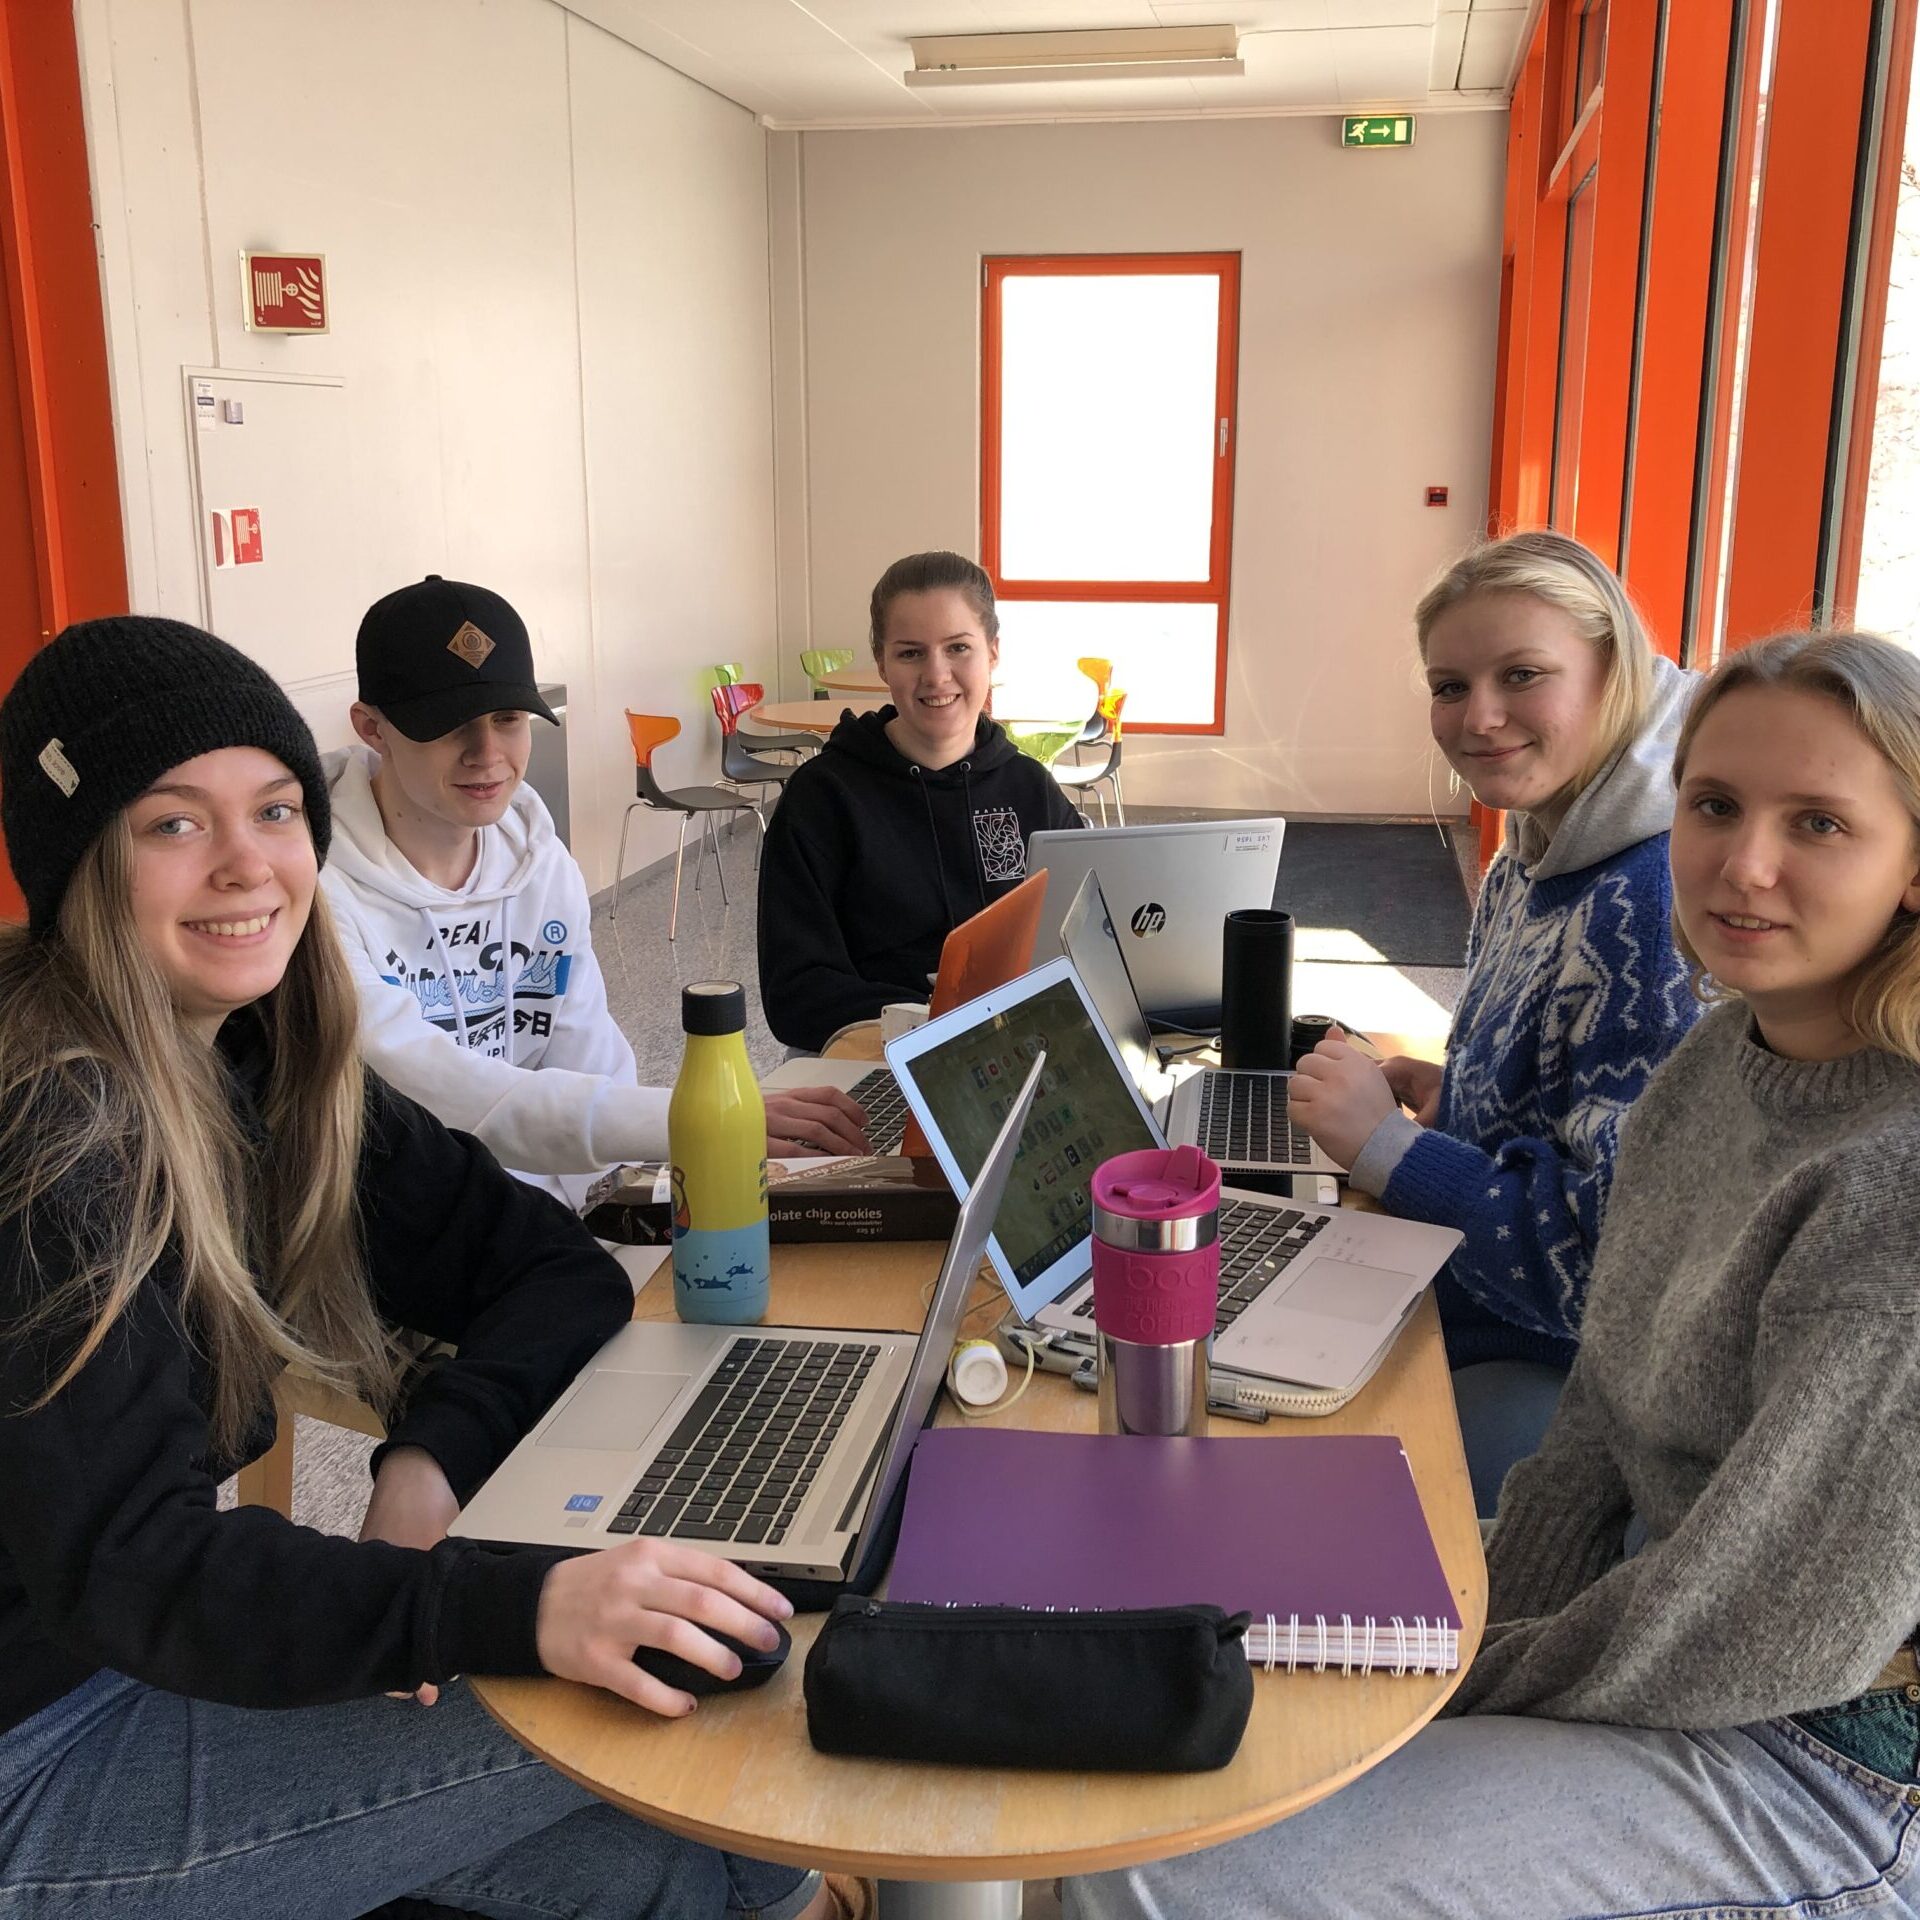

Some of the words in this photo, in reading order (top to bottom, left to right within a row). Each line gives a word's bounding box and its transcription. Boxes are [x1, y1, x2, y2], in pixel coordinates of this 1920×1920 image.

[1132, 902, 1166, 938] hp
[805, 1207, 831, 1221] chip
[834, 1207, 883, 1220] cookies
